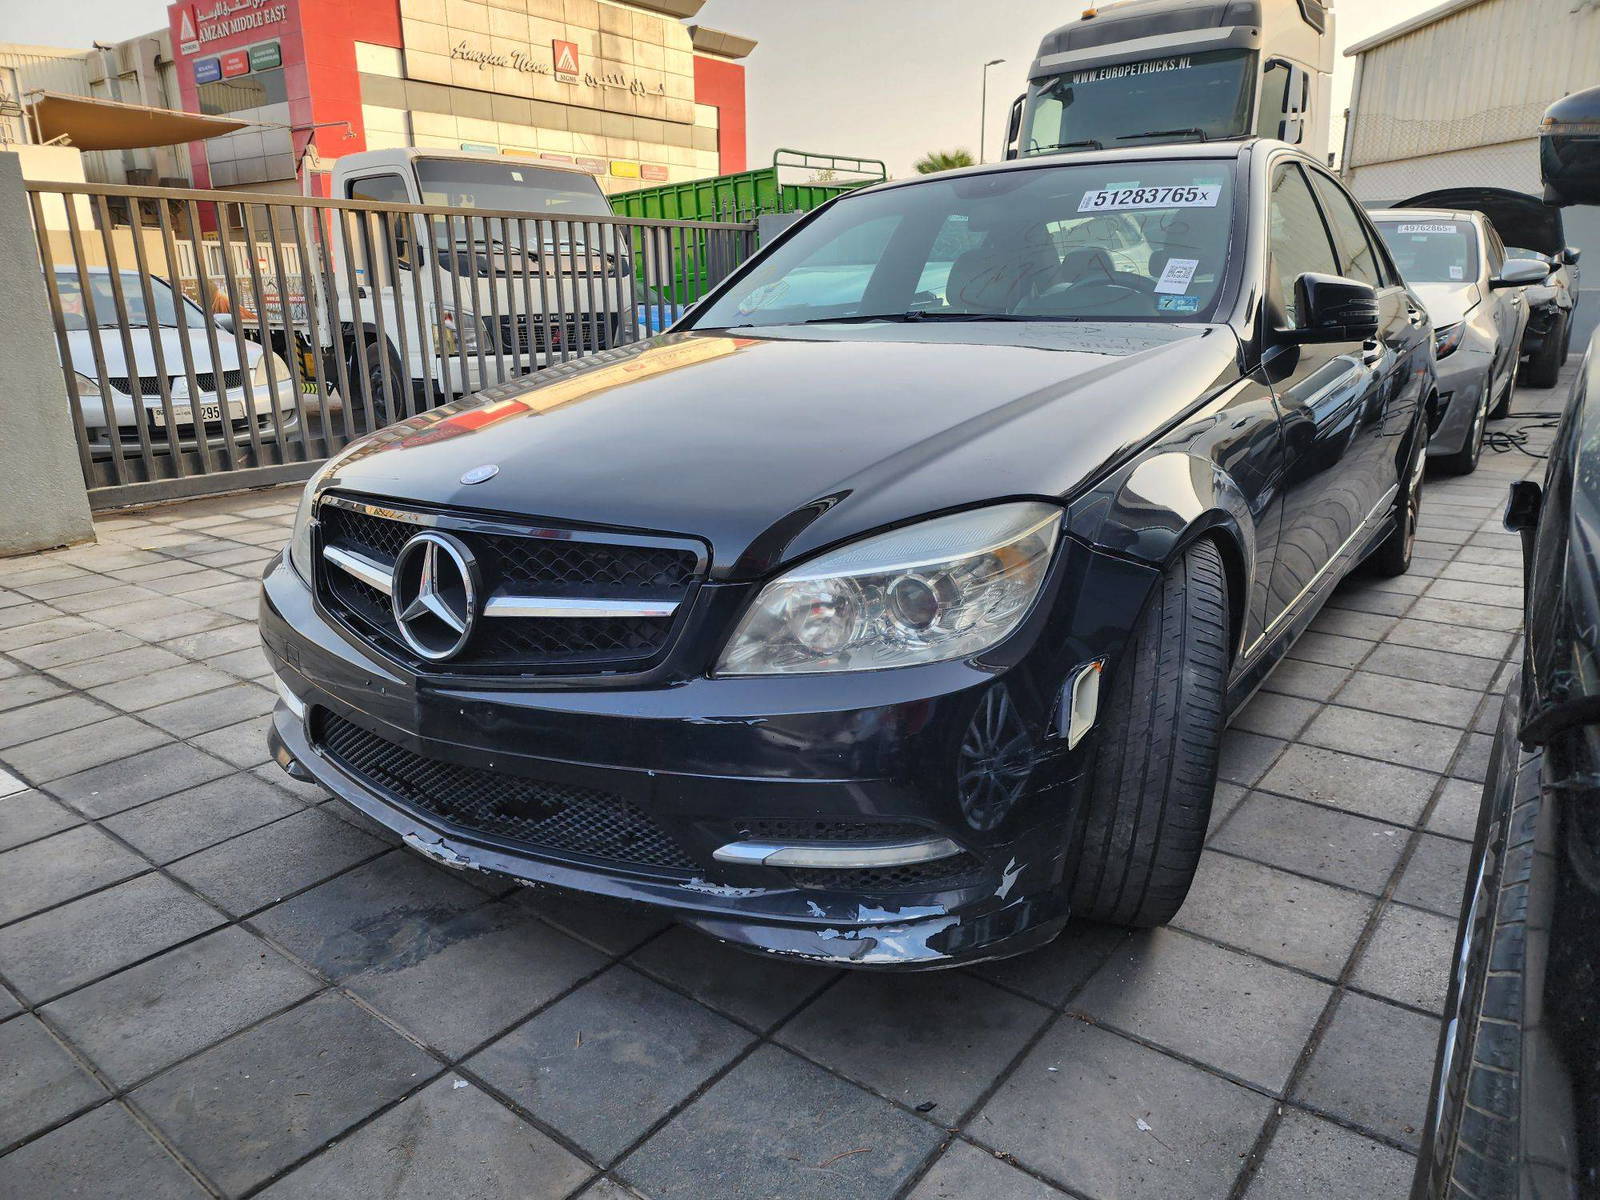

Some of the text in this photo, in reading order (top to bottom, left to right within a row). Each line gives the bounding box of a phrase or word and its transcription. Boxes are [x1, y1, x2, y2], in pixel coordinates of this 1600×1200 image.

[199, 5, 287, 43] AMZAN MIDDLE EAST
[511, 49, 550, 74] Neon
[1073, 57, 1192, 84] WWW.EUROPETRUCKS.NL
